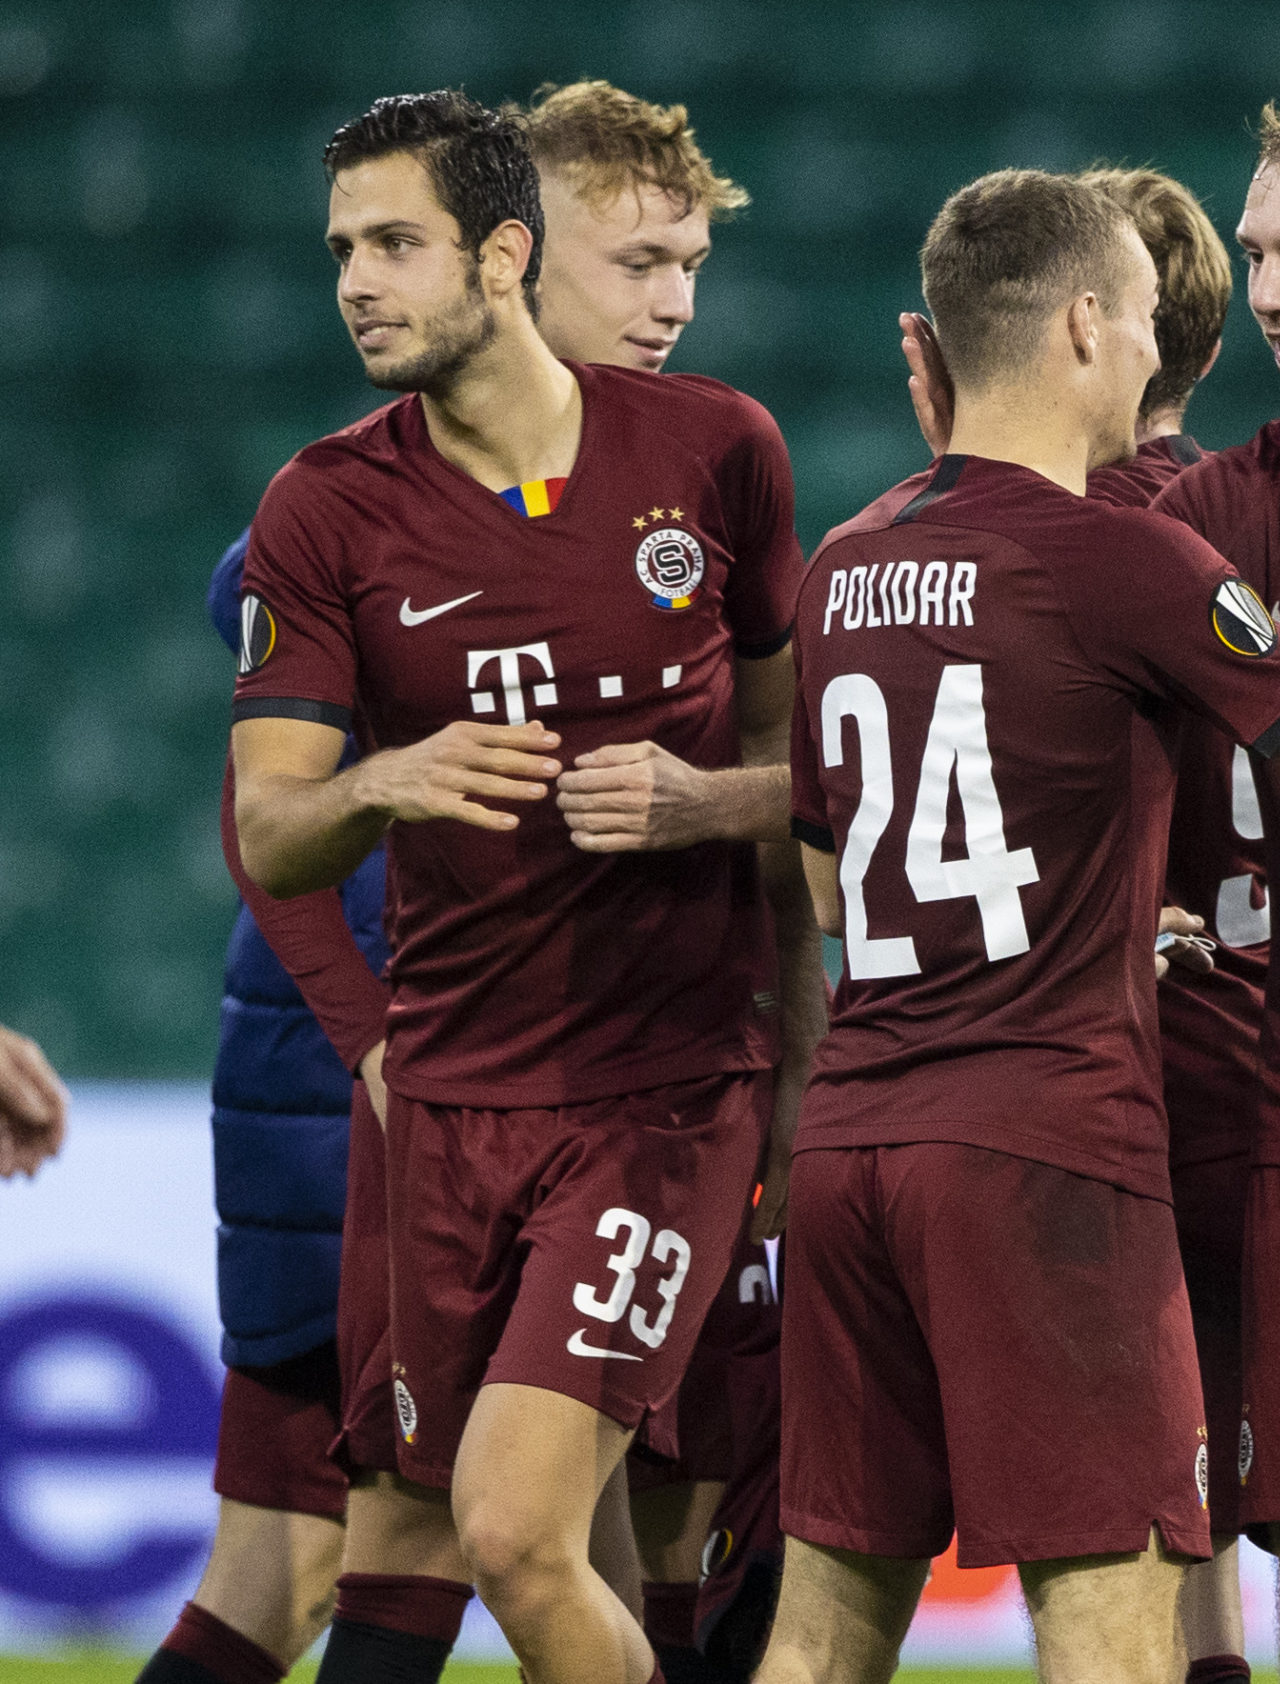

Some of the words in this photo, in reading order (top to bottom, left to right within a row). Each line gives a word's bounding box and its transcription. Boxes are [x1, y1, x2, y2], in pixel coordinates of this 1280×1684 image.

[639, 531, 673, 562] SPARTA
[680, 534, 702, 572] PRAHA
[823, 561, 977, 635] POLIDAR
[821, 664, 1040, 980] 24
[573, 1208, 691, 1349] 33
